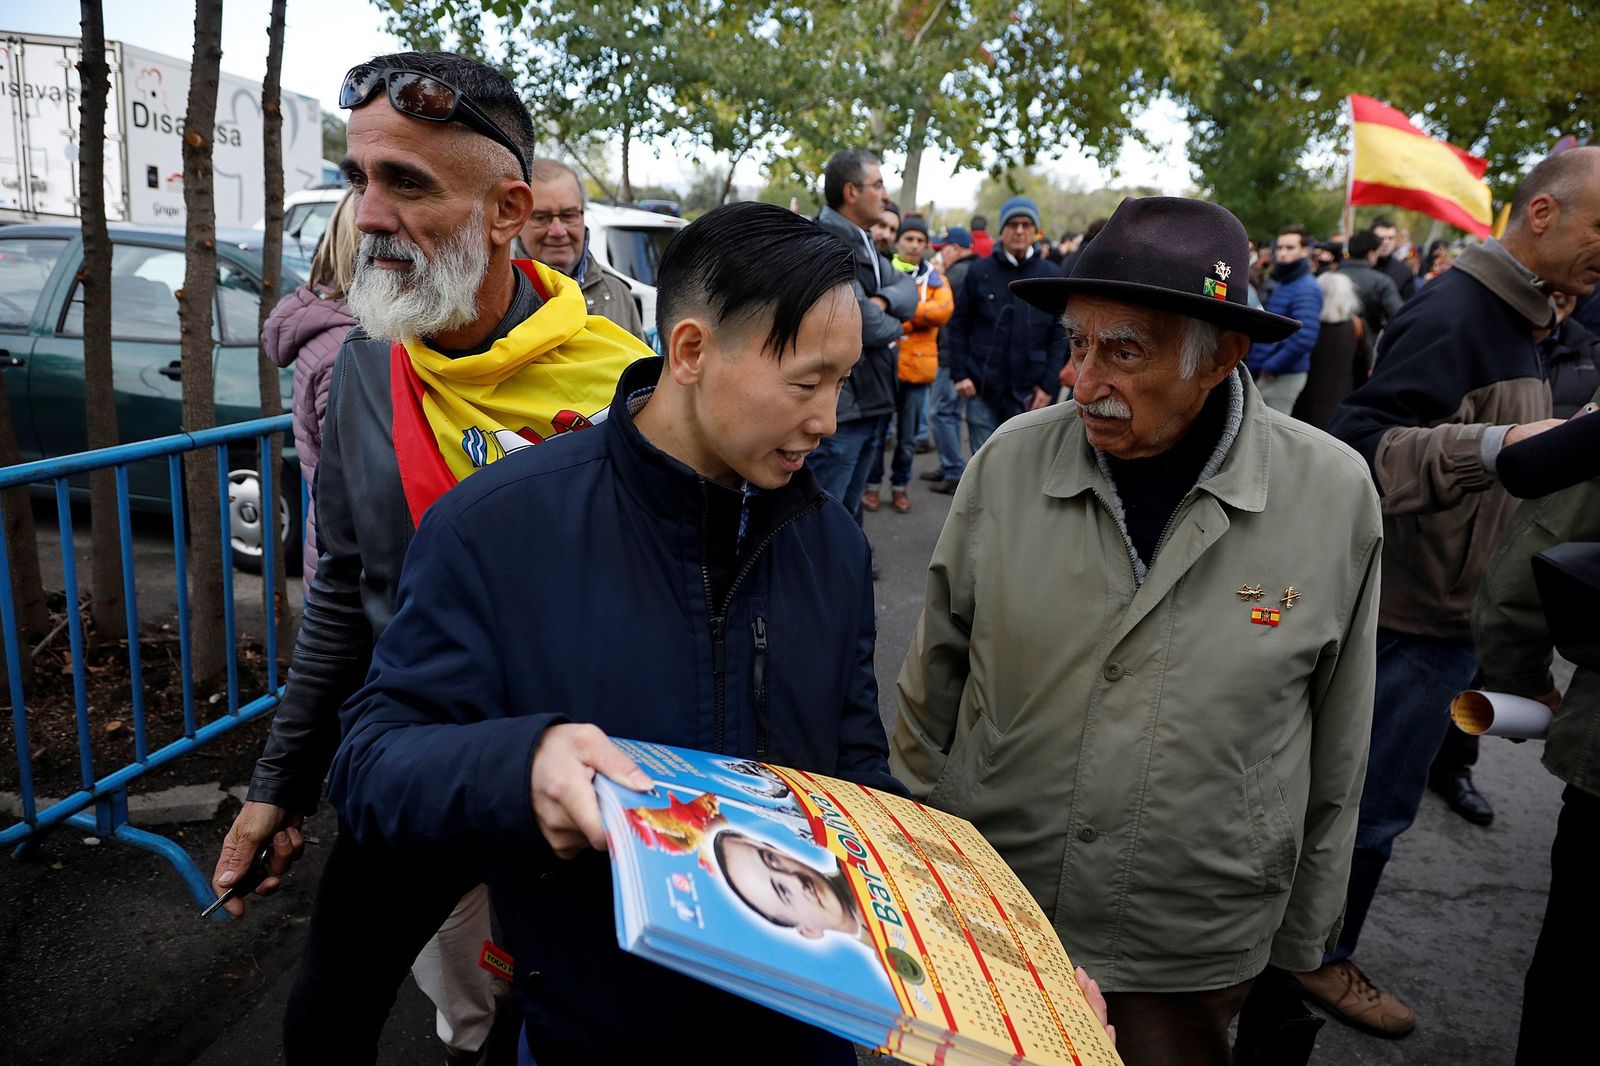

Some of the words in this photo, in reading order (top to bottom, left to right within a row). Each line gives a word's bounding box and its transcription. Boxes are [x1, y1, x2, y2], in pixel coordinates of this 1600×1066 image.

[1, 81, 77, 103] isavas
[132, 100, 242, 147] Disasa
[810, 794, 868, 859] Oliva
[858, 863, 903, 927] Bar
[883, 871, 908, 913] FEBRERO
[949, 902, 969, 932] JUNIO
[922, 954, 943, 993] ENERO
[988, 980, 1008, 1017] MAYO
[1040, 990, 1077, 1057] SEPTIEMBRE
